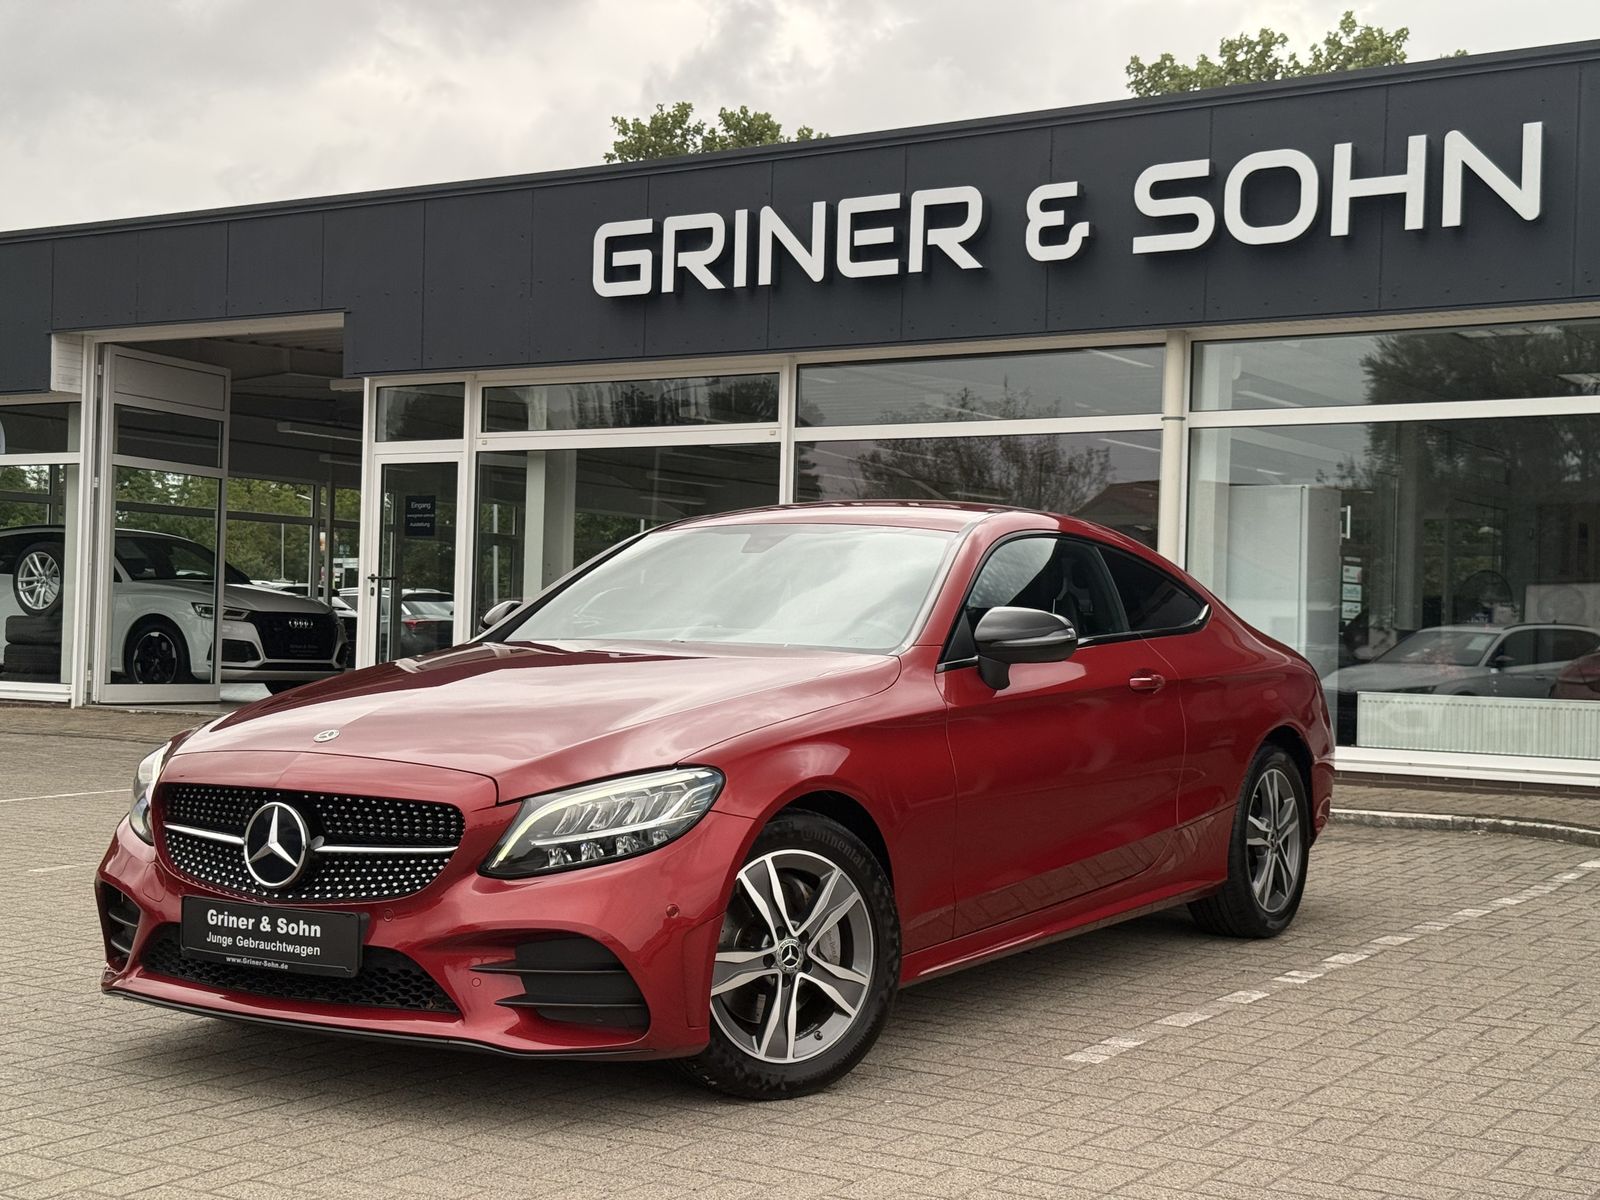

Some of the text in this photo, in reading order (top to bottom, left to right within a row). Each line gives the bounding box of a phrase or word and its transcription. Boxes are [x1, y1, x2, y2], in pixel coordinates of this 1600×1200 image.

[592, 121, 1543, 298] GRINER & SOHN
[207, 908, 321, 938] Griner & Sohn
[206, 931, 321, 957] Junge Gebrauchtwagen
[225, 956, 289, 970] www.Griner-Sohn.de
